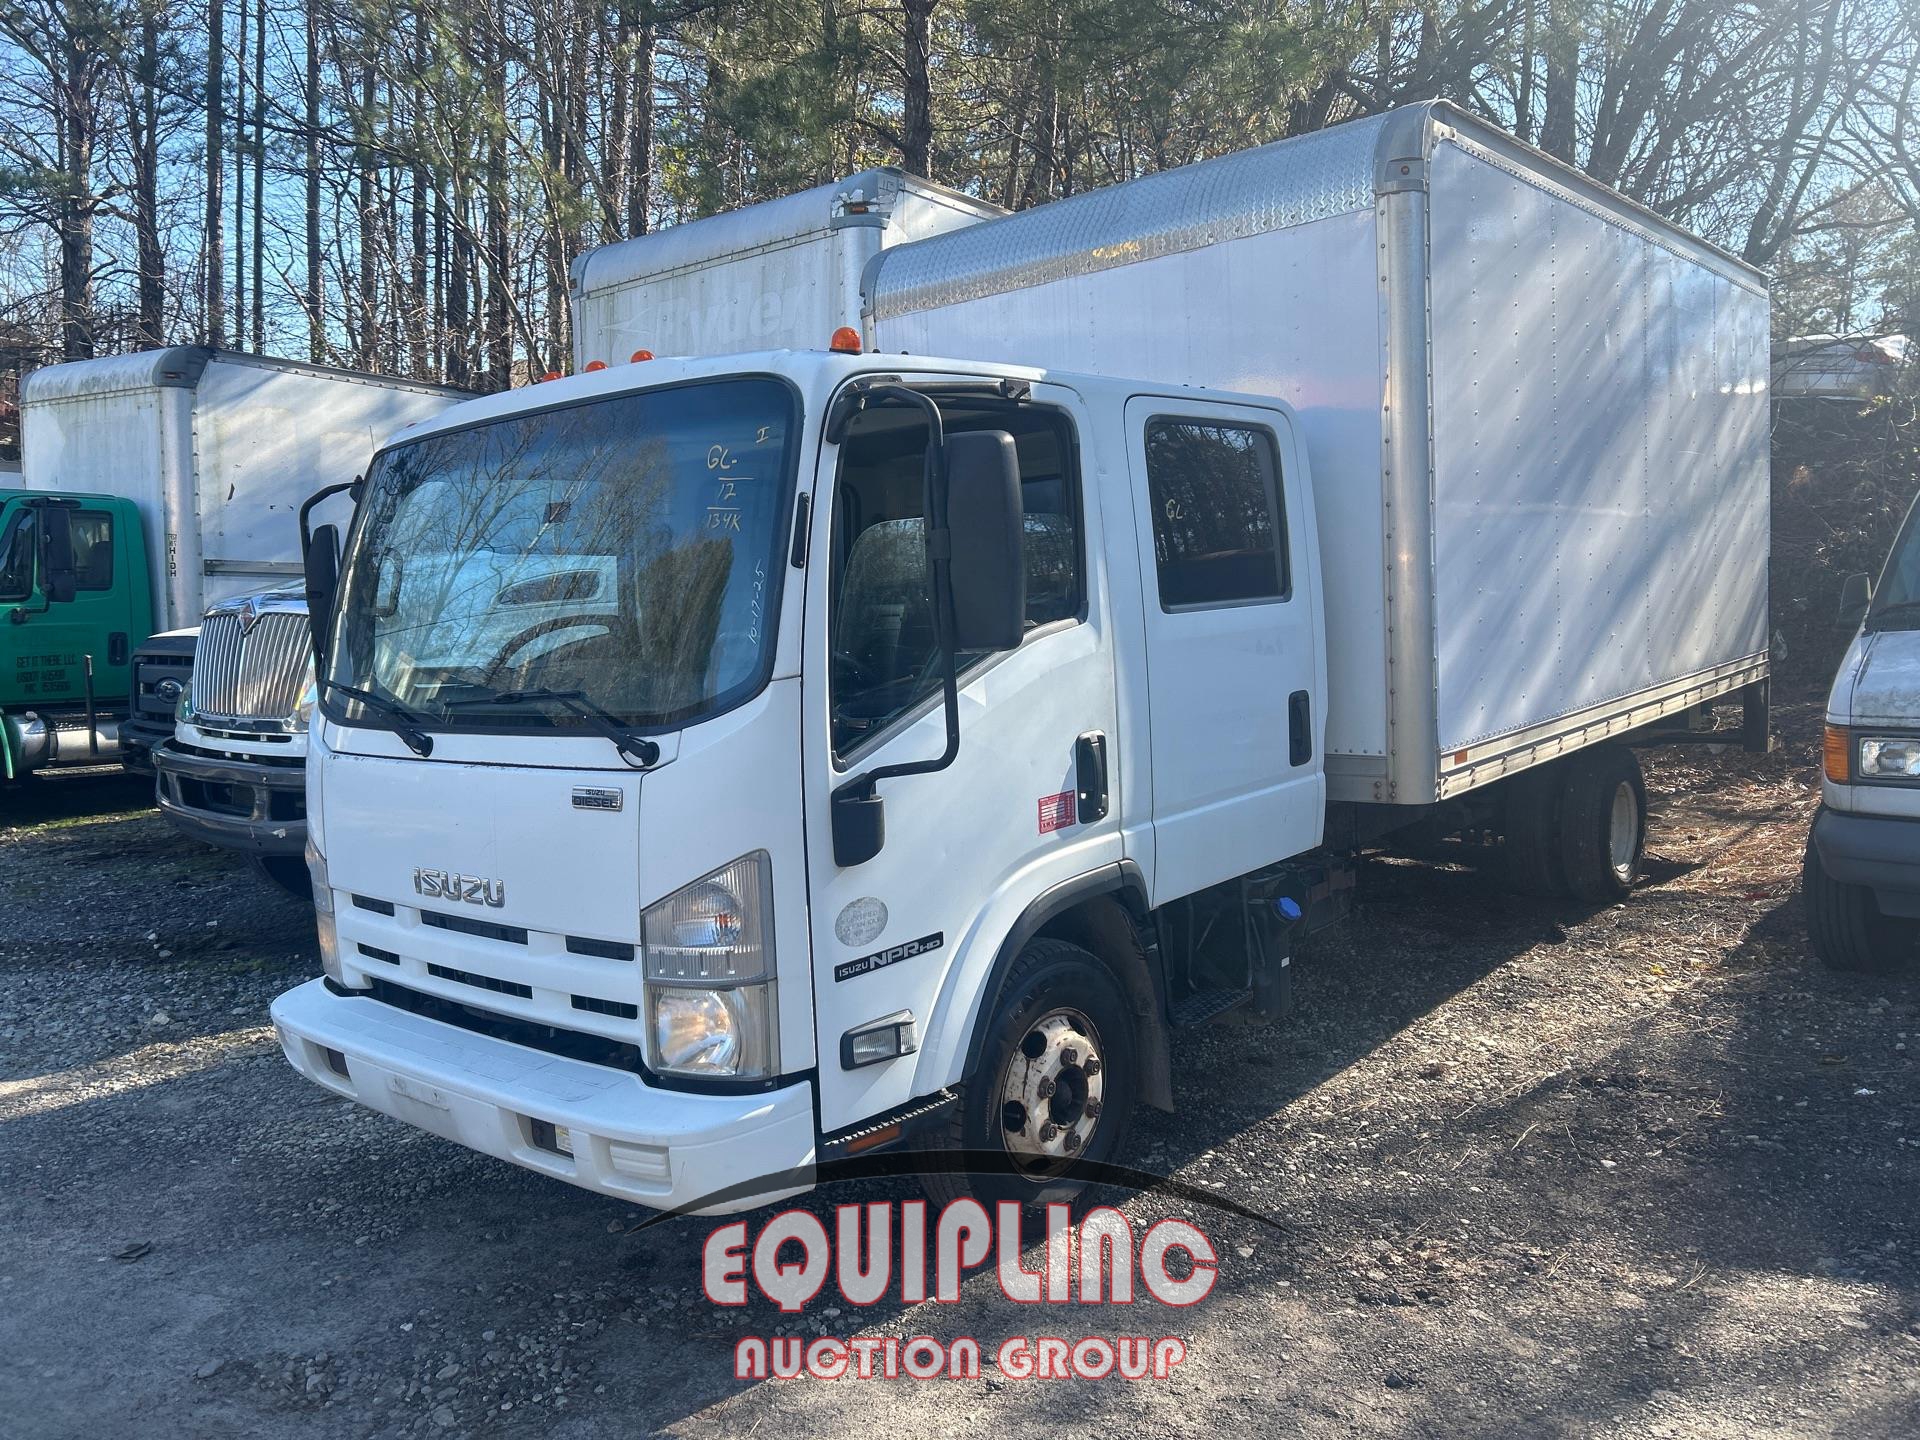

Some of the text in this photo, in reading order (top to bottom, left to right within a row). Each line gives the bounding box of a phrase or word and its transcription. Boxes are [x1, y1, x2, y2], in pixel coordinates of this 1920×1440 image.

[574, 796, 619, 808] DIESEL
[414, 867, 505, 908] ISUZU
[840, 961, 868, 977] ISUZU
[869, 941, 920, 970] NPR
